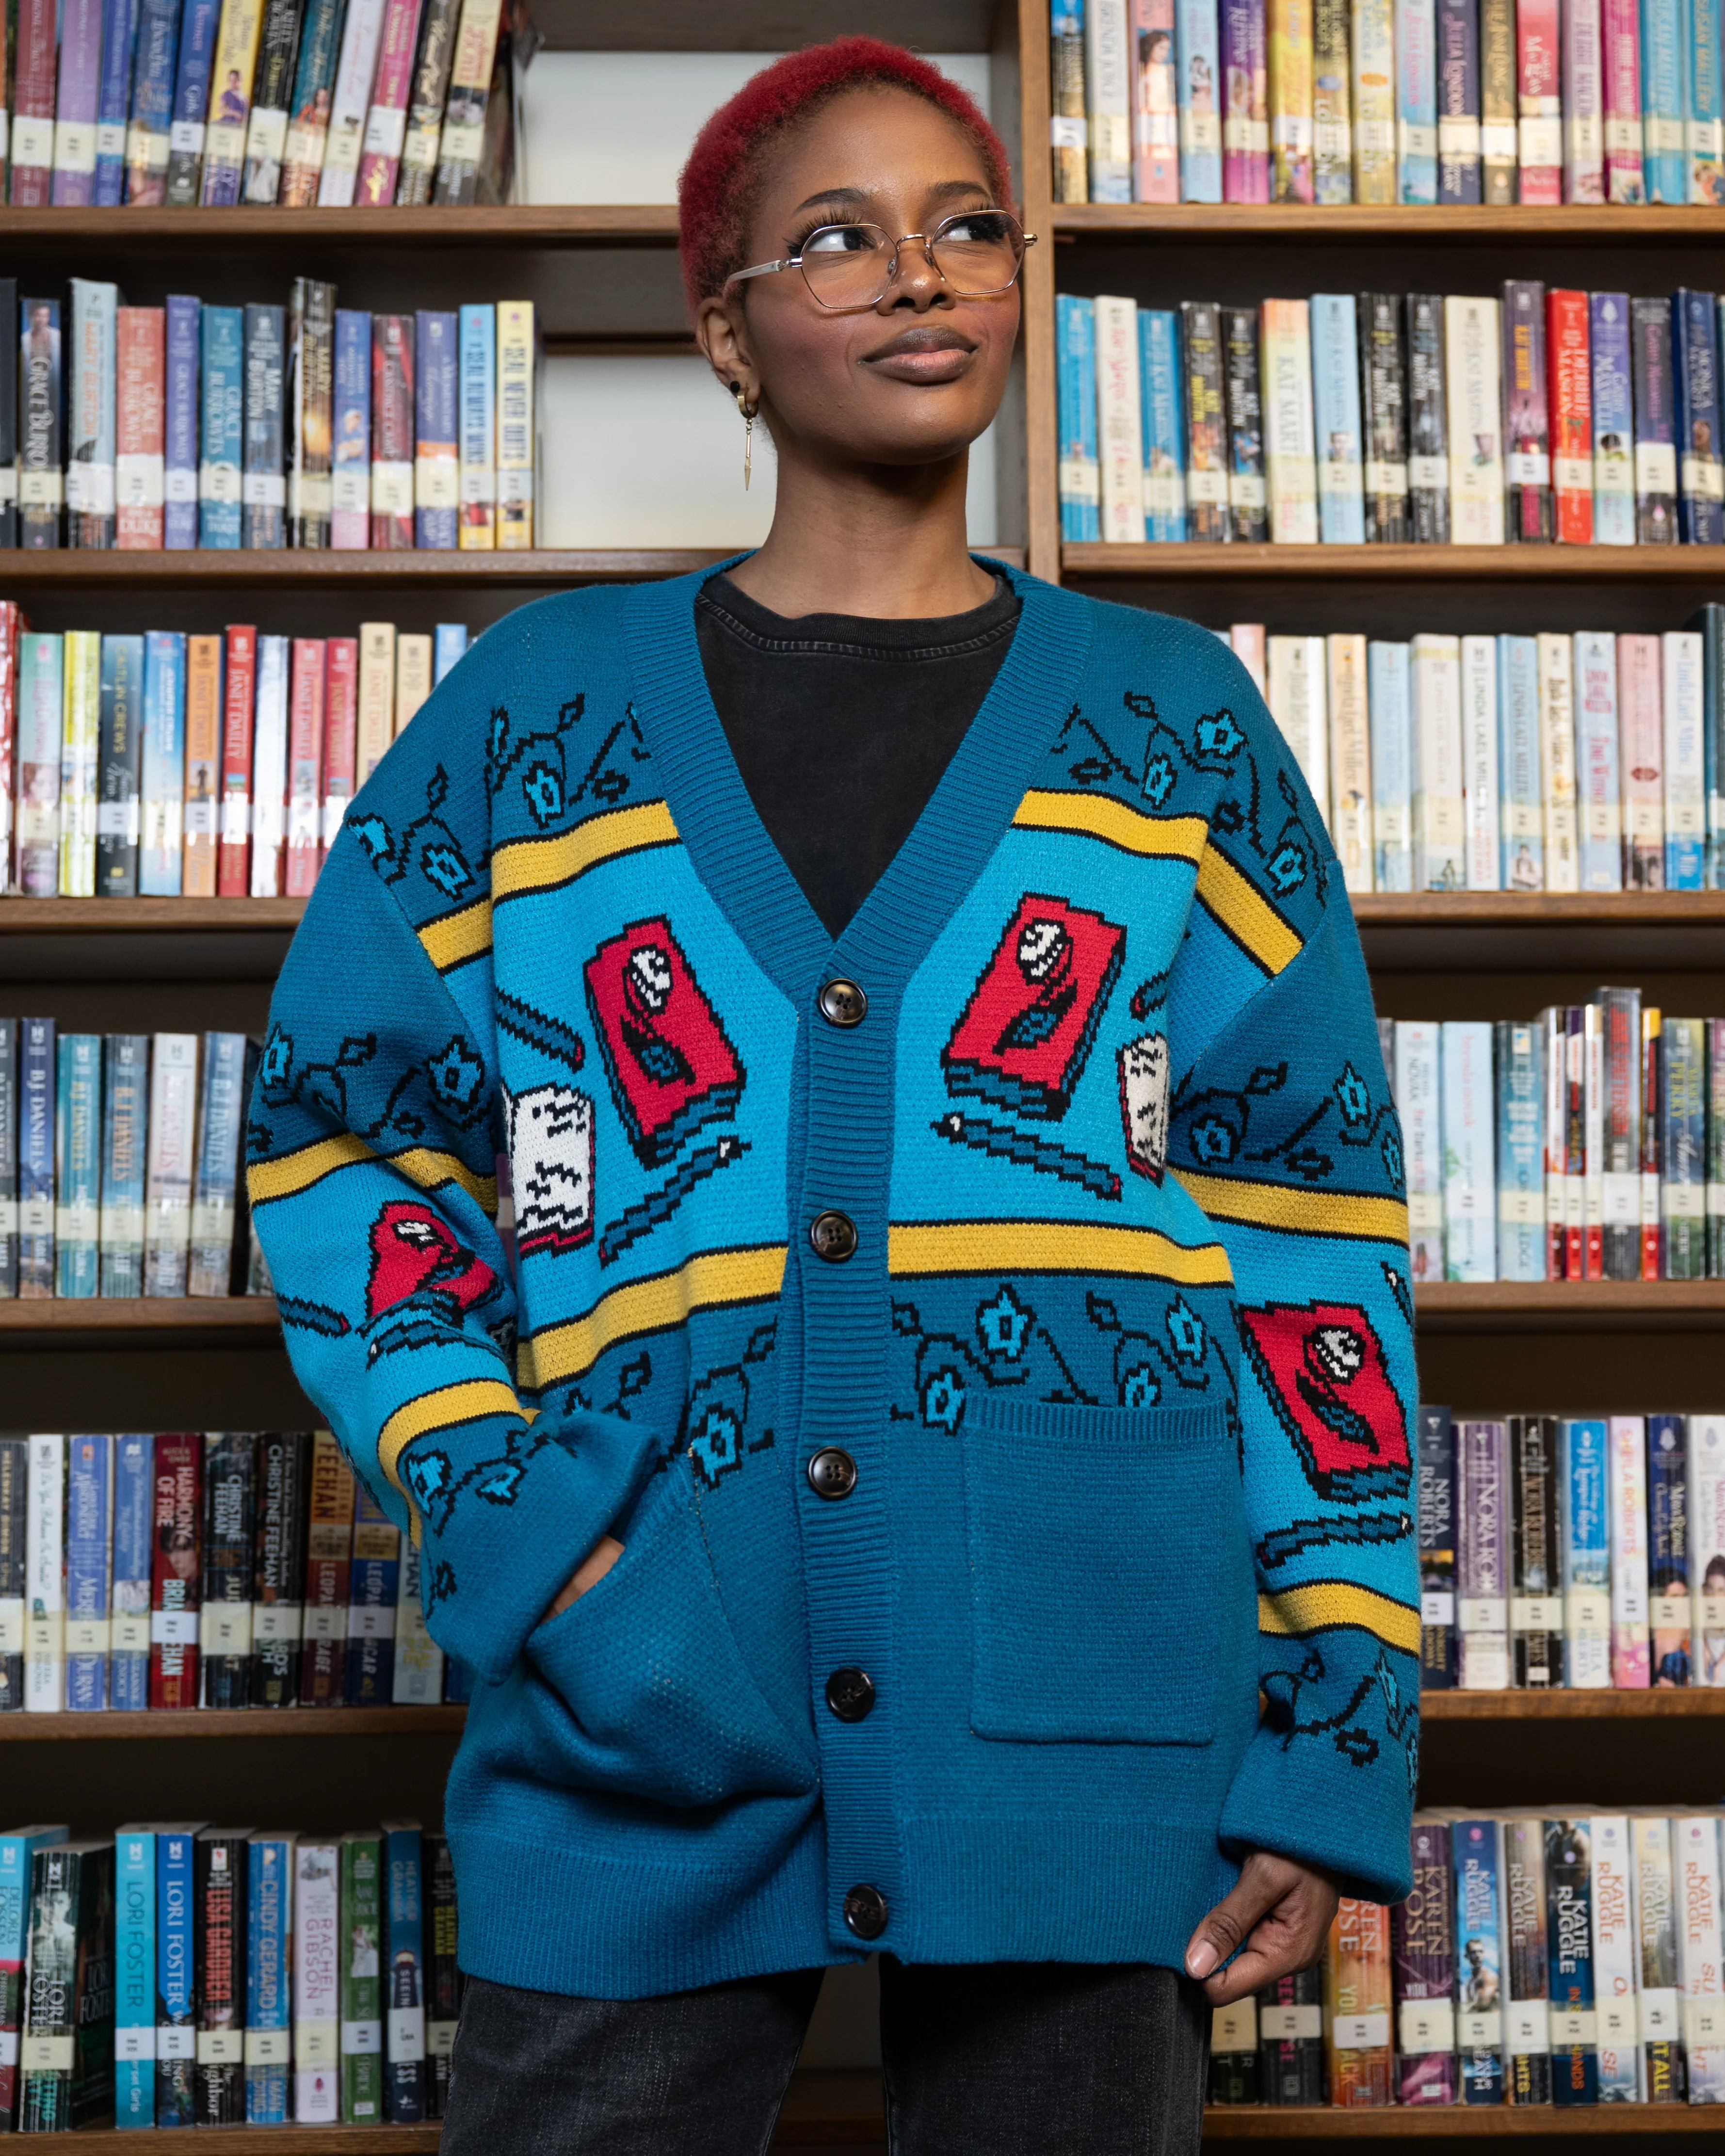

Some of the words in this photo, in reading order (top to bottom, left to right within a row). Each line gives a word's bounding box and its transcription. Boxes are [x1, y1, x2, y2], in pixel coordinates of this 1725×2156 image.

[1442, 12, 1467, 58] JULIA
[83, 322, 97, 367] MARY
[303, 336, 316, 402] BURTON
[317, 346, 330, 395] MARY
[29, 356, 52, 409] GRACE
[248, 359, 266, 419] BURTON
[265, 369, 281, 412] MARY
[1191, 375, 1206, 422] MARTIN
[1277, 355, 1295, 390] KAT
[1372, 368, 1386, 415] MARTIN
[1413, 353, 1425, 401] MARTIN
[1559, 349, 1573, 414] MASON
[82, 370, 97, 436] BURTON
[124, 369, 142, 451] BURROWES
[142, 382, 159, 436] GRACE
[208, 370, 224, 454] BURROWES
[225, 386, 242, 439] GRACE
[503, 382, 527, 419] NEVER
[1230, 378, 1244, 427] MARTIN
[114, 645, 127, 700] CAITLIN
[227, 669, 244, 709] JANET
[299, 673, 313, 710] JANET
[1474, 677, 1487, 719] LINDA
[113, 703, 126, 754] CREWS
[226, 711, 242, 759] DAILEY
[1475, 724, 1487, 756] LAEL
[1610, 1008, 1629, 1056] JAMES
[1408, 1057, 1419, 1102] NOVAK
[1610, 1057, 1630, 1136] PATTERSON
[1669, 1062, 1687, 1121] PERRY
[29, 1096, 46, 1171] DANIELS
[1462, 1087, 1474, 1127] novak
[72, 1105, 87, 1171] DANIELS
[1517, 1231, 1530, 1271] EDGE
[315, 1442, 338, 1519] FEEHAN
[1620, 1428, 1634, 1482] SHEILA
[157, 1476, 174, 1496] OF
[176, 1466, 194, 1538] HARMONY
[214, 1482, 229, 1534] FEEHAN
[226, 1474, 242, 1542] CHRISTINE
[266, 1445, 282, 1525] CHRISTINE
[1419, 1465, 1435, 1547] ROBERTS
[1435, 1478, 1450, 1534] NORA
[1525, 1475, 1544, 1513] NORA
[157, 1497, 174, 1528] FIRE
[1476, 1482, 1499, 1543] NORA
[1623, 1486, 1636, 1555] ROBERTS
[264, 1526, 280, 1588] FEEHAN
[1525, 1515, 1546, 1568] ROBERTS
[116, 1658, 128, 1697] ENOCH
[7, 1886, 20, 1944] DELORES
[127, 1881, 144, 1925] LORI
[166, 1881, 184, 1926] LORI
[205, 1889, 232, 1923] LISA
[259, 1880, 277, 1932] CINDY
[391, 1860, 403, 1922] GRAHAM
[405, 1860, 418, 1922] HEATHER
[1404, 1867, 1425, 1957] ROSE
[1425, 1866, 1442, 1957] KAREN
[1466, 1859, 1479, 1931] RUGGLE
[1478, 1870, 1491, 1918] KATIE
[1509, 1863, 1525, 1948] RUGGLE
[1521, 1876, 1538, 1933] KATIE
[1597, 1861, 1613, 1945] RUGGLE
[1611, 1875, 1626, 1930] KATIE
[1641, 1863, 1656, 1947] RUGGLE
[1655, 1873, 1670, 1934] KATIE
[1685, 1862, 1701, 1946] RUGGLE
[1698, 1875, 1714, 1930] KATIE
[320, 1918, 333, 1995] RACHEL
[434, 1906, 444, 1955] GRAHAM
[445, 1906, 455, 1955] HEATHER
[1557, 1885, 1576, 1975] RUGGLE
[1572, 1900, 1589, 1959] KATIE
[127, 1931, 144, 2008] FOSTER
[166, 1934, 184, 2006] FOSTER
[205, 1927, 232, 2001] GARDNER
[258, 1937, 277, 2009] GERARD
[306, 1918, 320, 2000] GIBSON
[48, 1980, 65, 2025] LORI
[399, 1969, 411, 2008] SEEIN
[202, 2064, 222, 2116] ighbor
[1339, 2049, 1355, 2086] ACK
[1653, 2059, 1671, 2094] ALL
[130, 2088, 142, 2112] Girls
